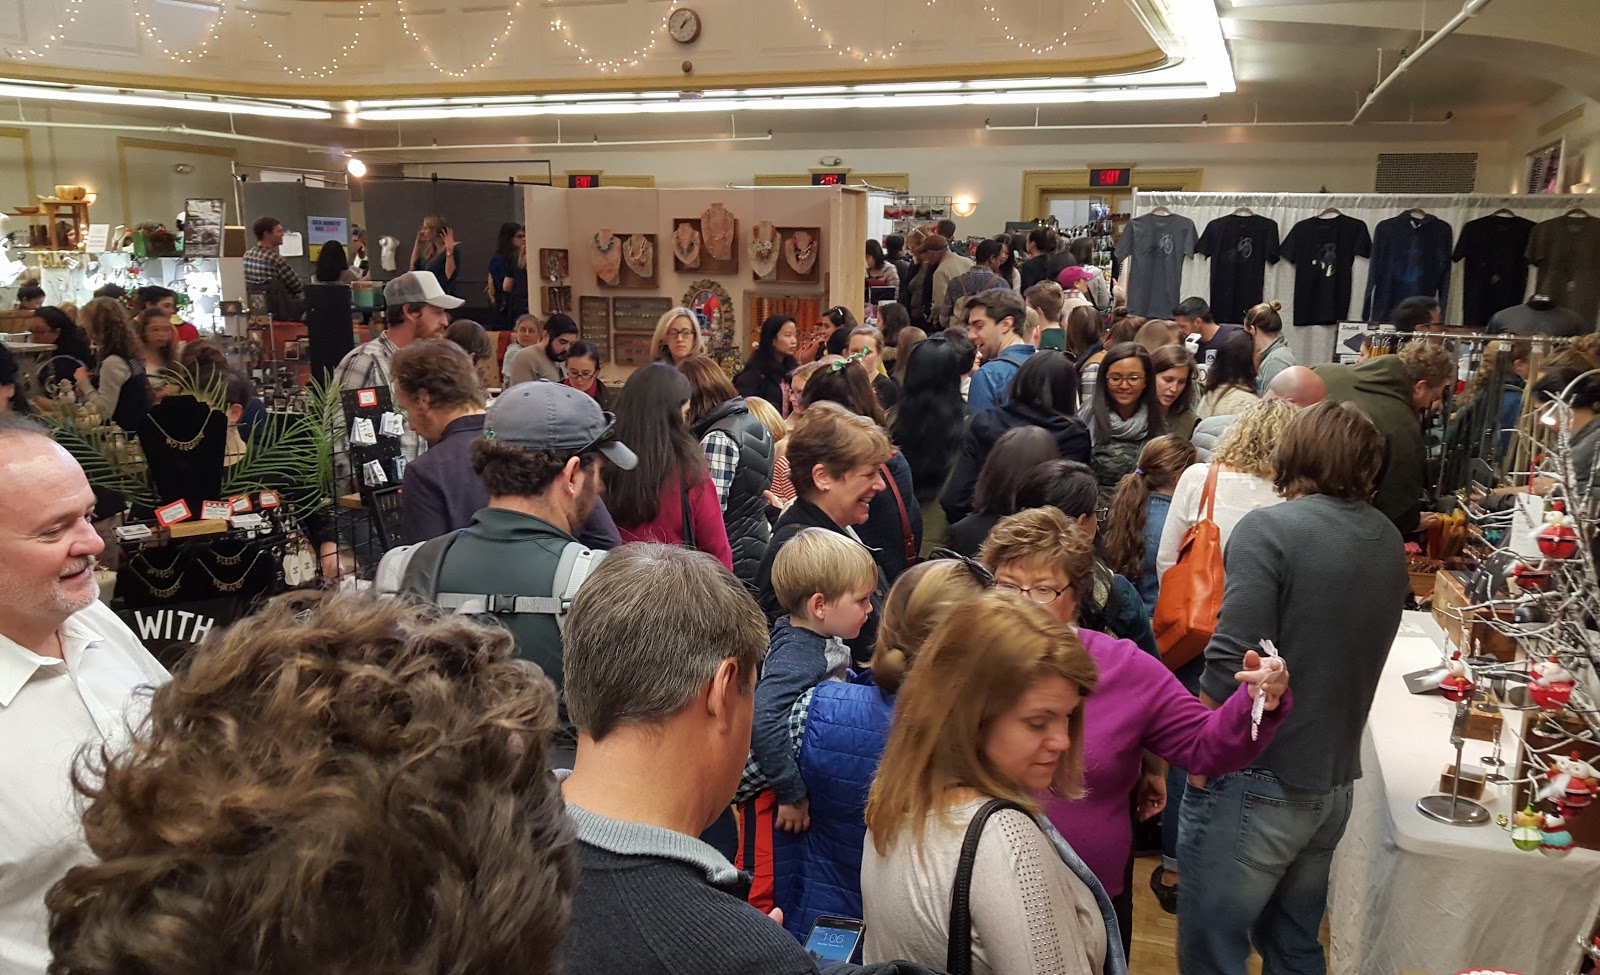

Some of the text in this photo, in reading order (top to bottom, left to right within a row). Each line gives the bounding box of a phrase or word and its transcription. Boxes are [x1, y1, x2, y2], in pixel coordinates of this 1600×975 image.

[575, 175, 591, 188] EXIT
[1099, 169, 1120, 185] EXIT
[134, 609, 215, 644] WITH
[823, 932, 845, 944] 1:06
